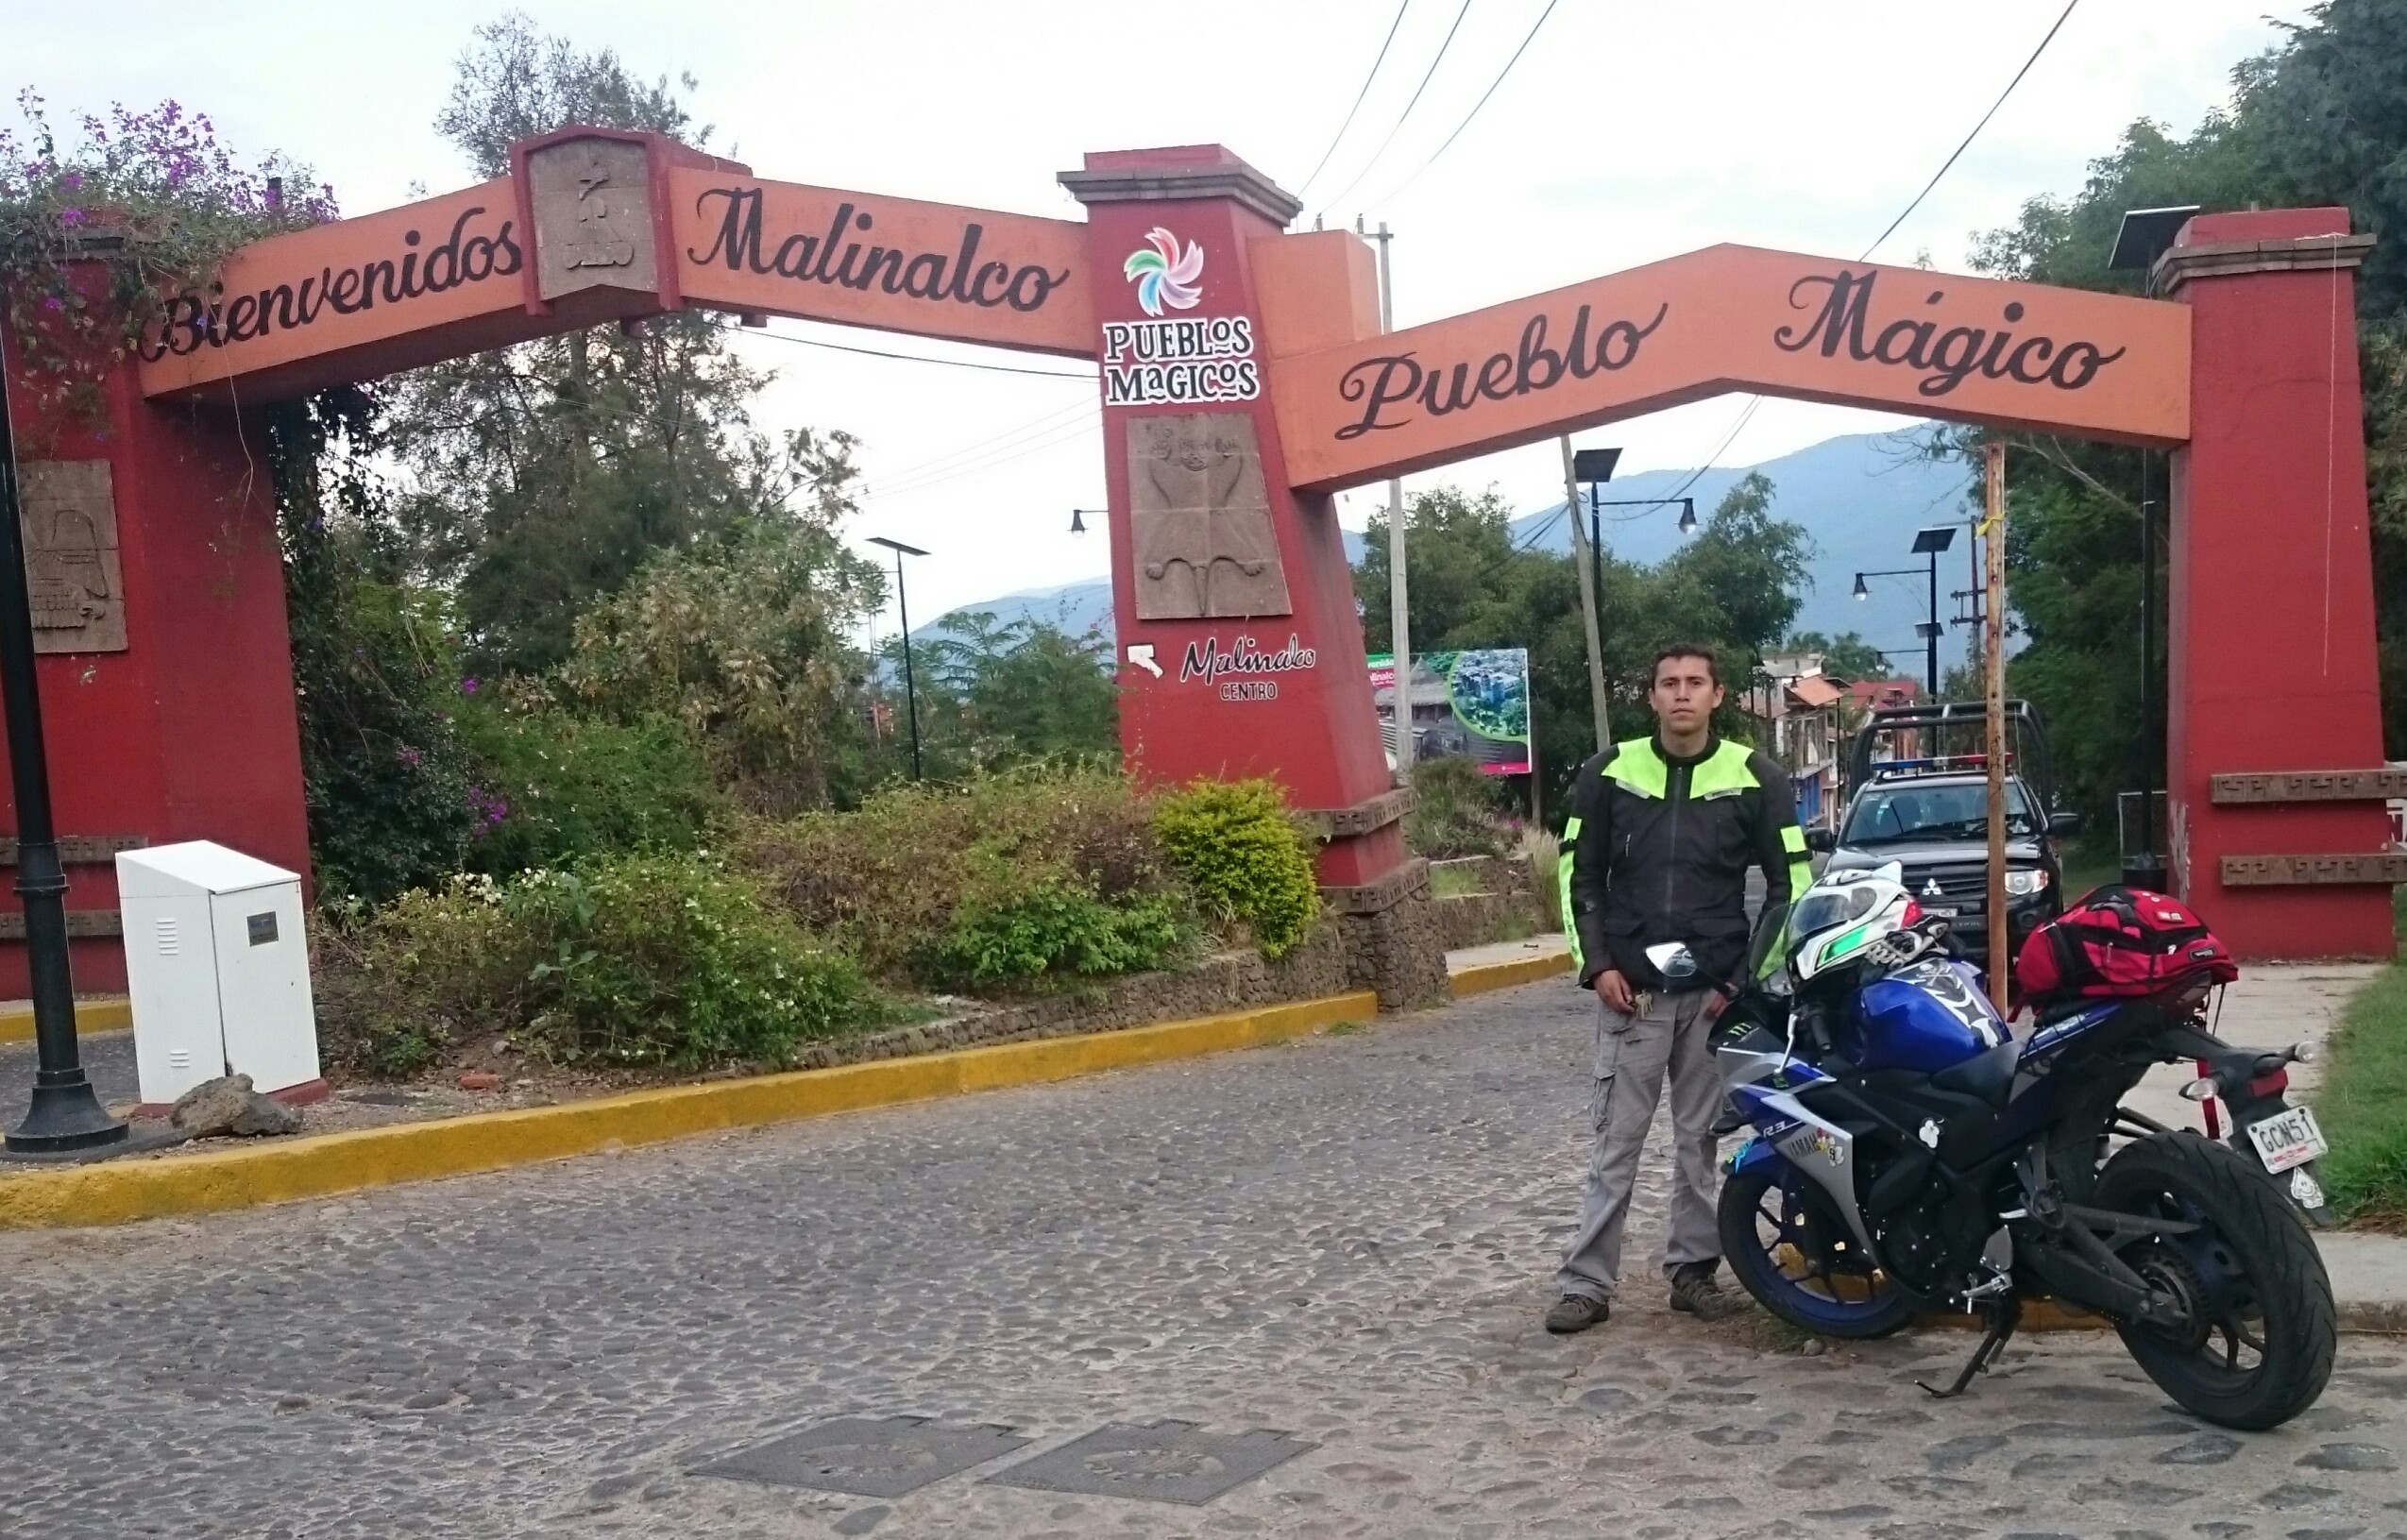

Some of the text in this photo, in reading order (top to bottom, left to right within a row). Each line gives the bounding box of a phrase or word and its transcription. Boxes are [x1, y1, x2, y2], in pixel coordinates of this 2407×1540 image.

[687, 186, 1070, 313] Malinalco
[139, 206, 522, 363] Bienvenidos
[1105, 318, 1253, 362] PUEBLOS
[1334, 269, 2126, 441] Pueblo Mágico
[1180, 634, 1316, 685] Malinalco
[1220, 682, 1278, 702] CENTRO
[1787, 1133, 1819, 1159] YAMAH
